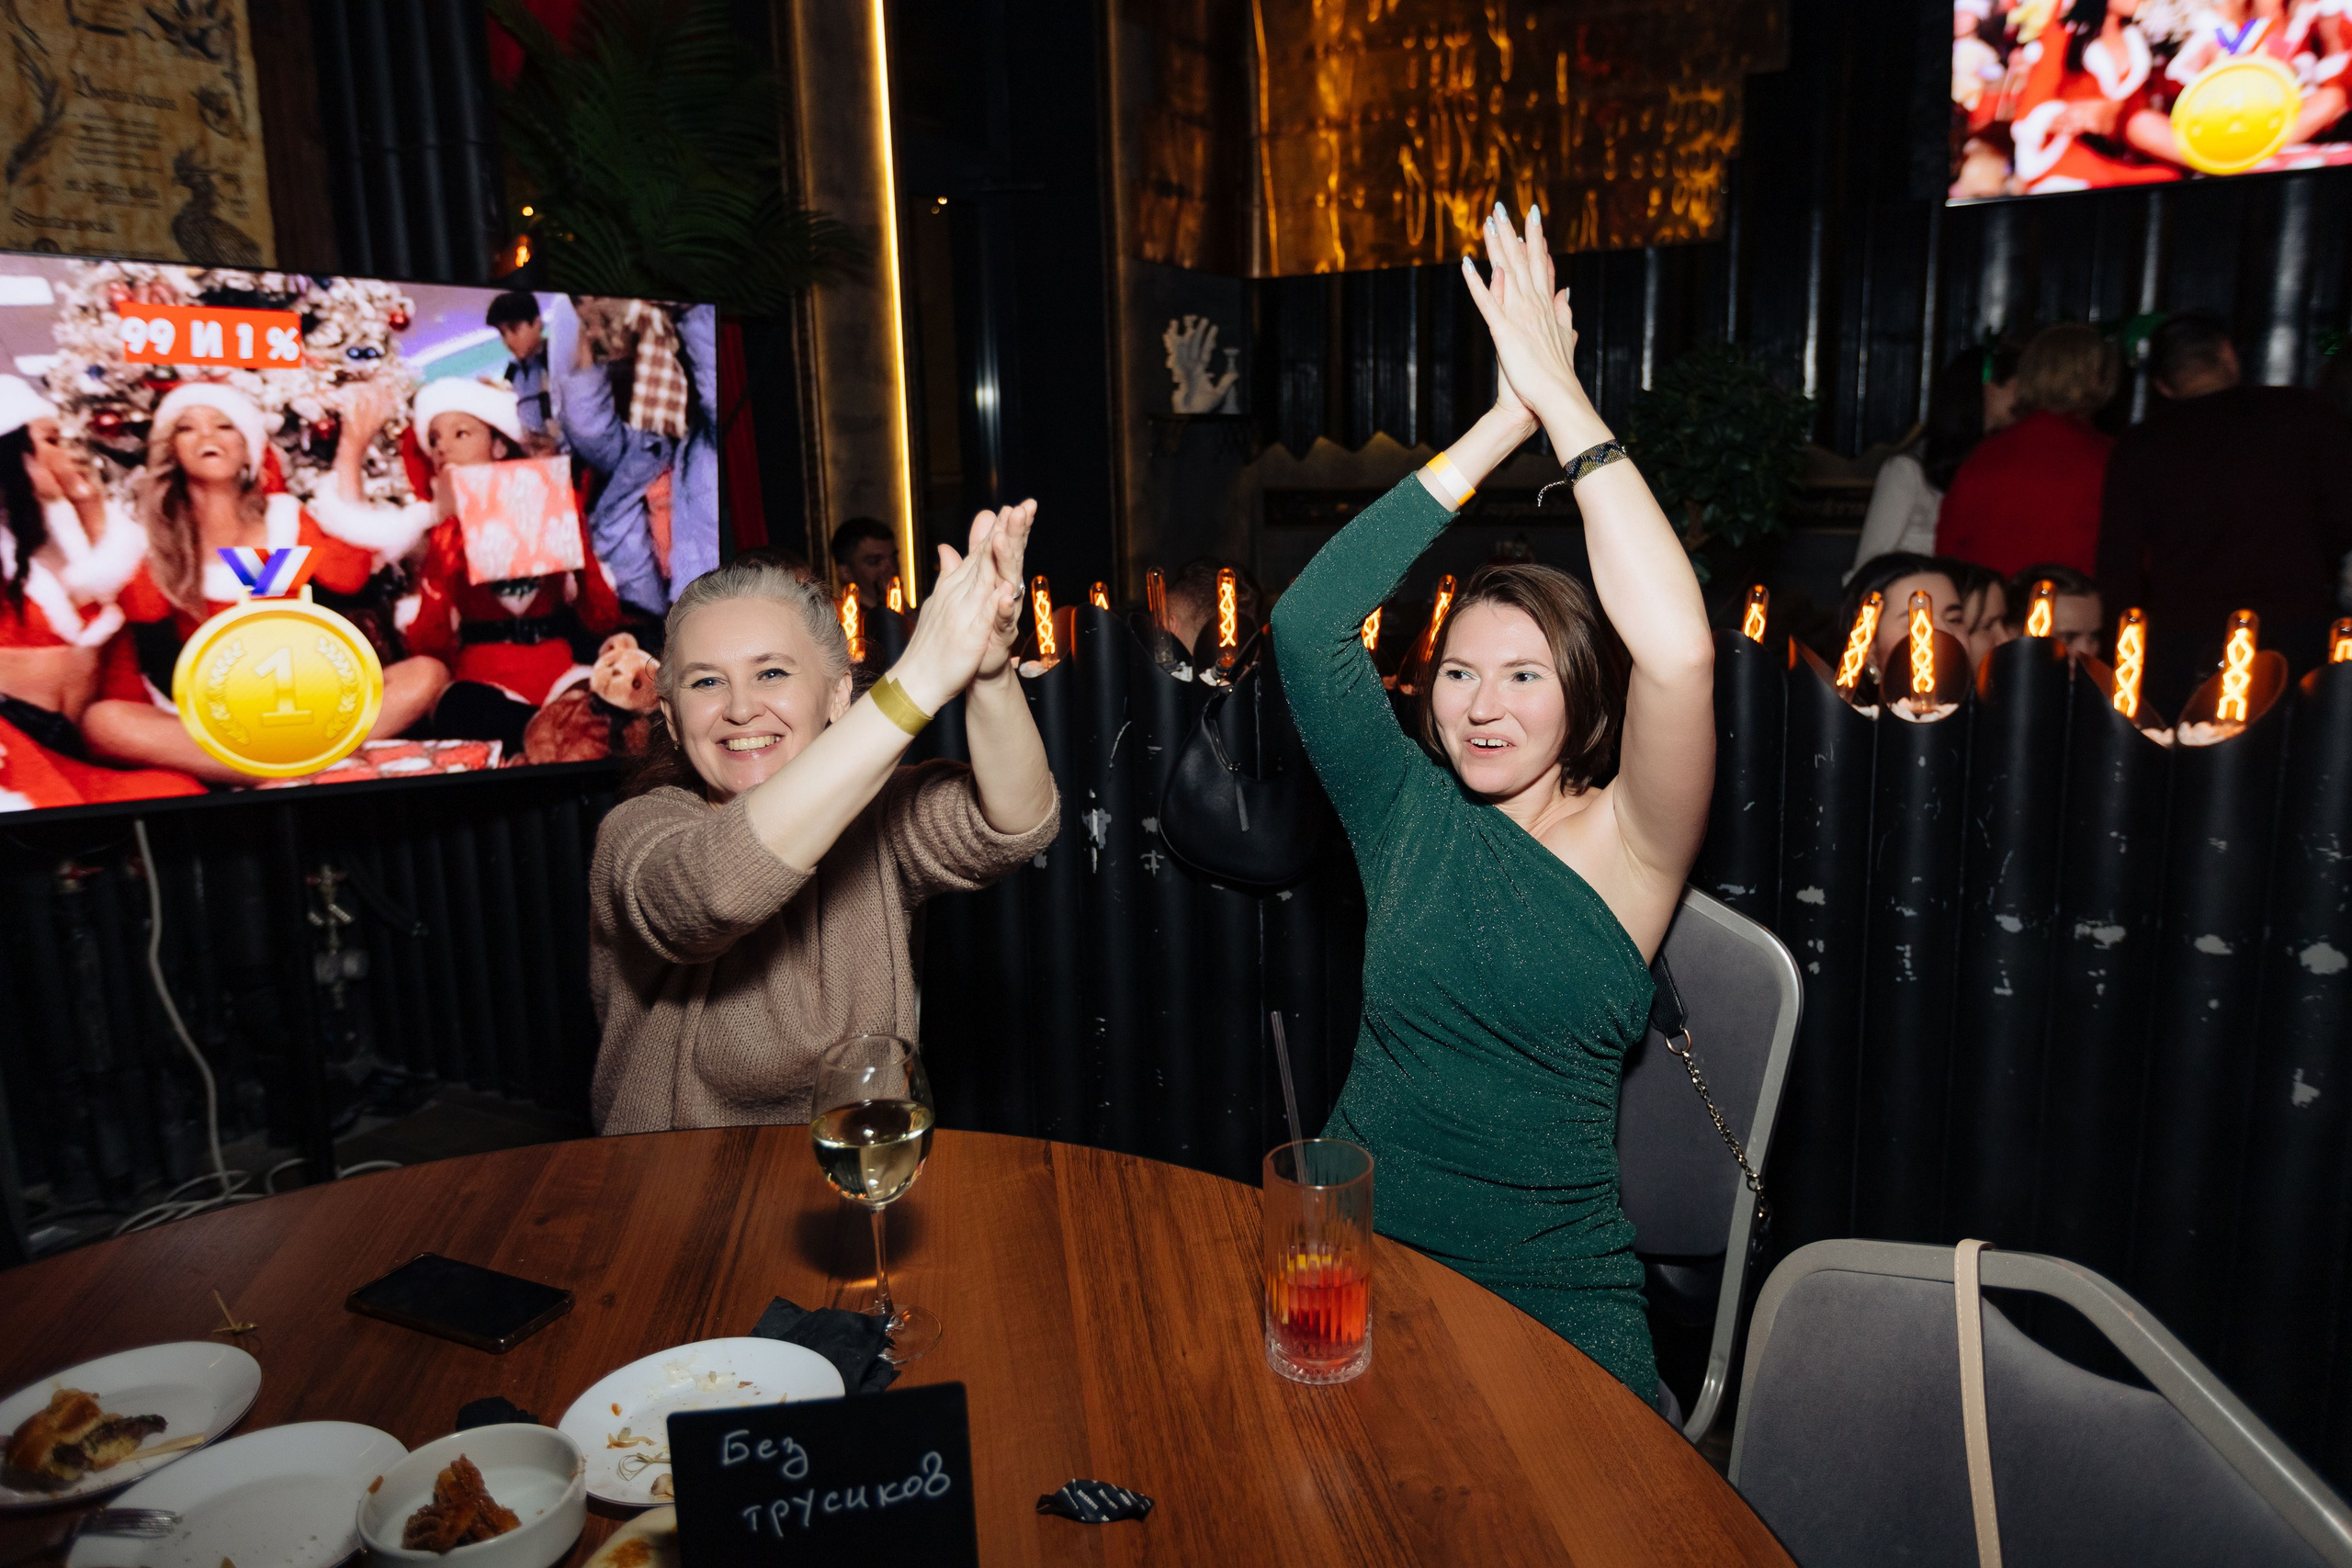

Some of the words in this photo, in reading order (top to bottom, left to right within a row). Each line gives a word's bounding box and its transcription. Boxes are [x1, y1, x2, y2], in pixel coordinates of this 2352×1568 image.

[121, 316, 175, 355] 99
[190, 320, 223, 357] И
[235, 322, 254, 359] 1
[266, 326, 300, 361] %
[254, 648, 314, 726] 1
[721, 1429, 809, 1479] Без
[742, 1451, 951, 1537] трусиков
